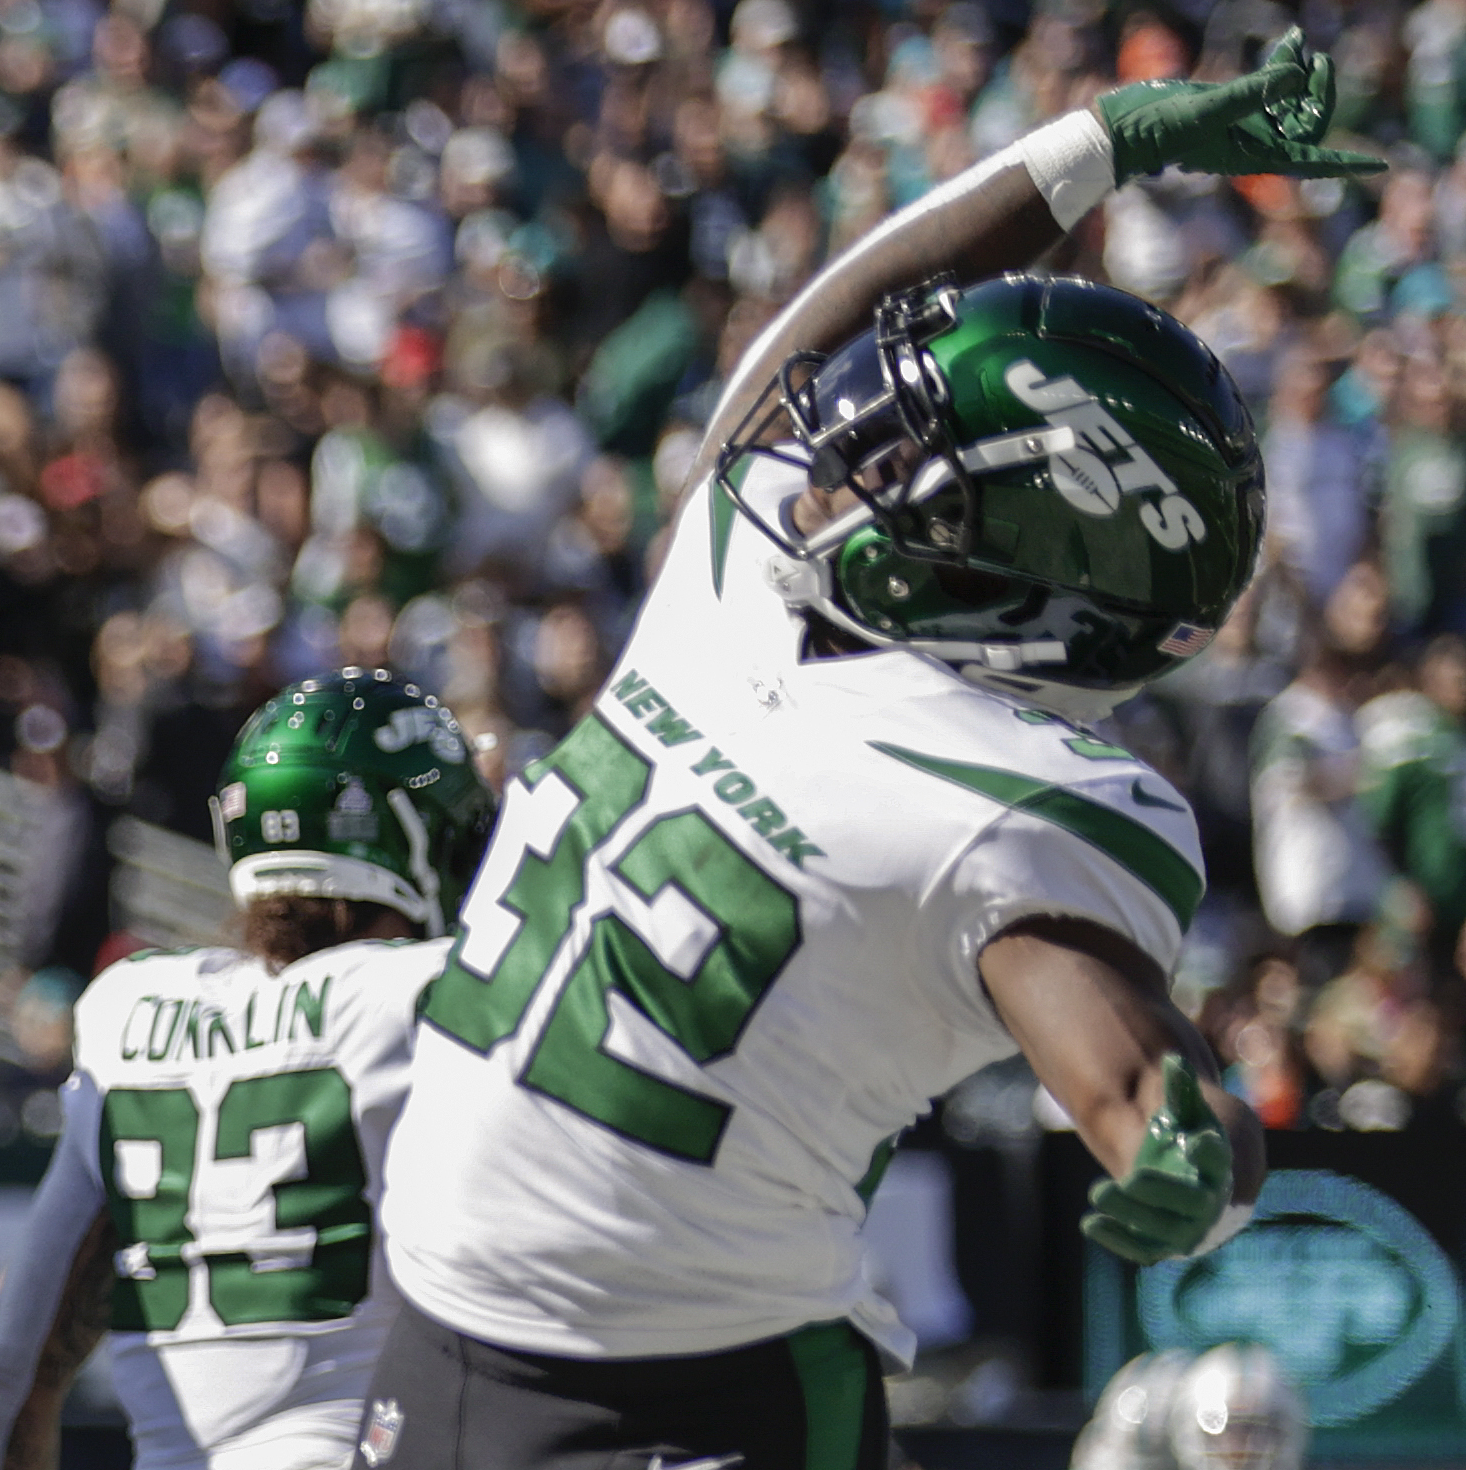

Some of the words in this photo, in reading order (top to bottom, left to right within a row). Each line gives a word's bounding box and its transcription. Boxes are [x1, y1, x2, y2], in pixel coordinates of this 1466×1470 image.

[1004, 358, 1207, 552] JETS
[610, 668, 705, 748] NEW
[690, 746, 828, 870] YORK
[414, 711, 805, 1168] 32
[99, 1065, 373, 1332] 83
